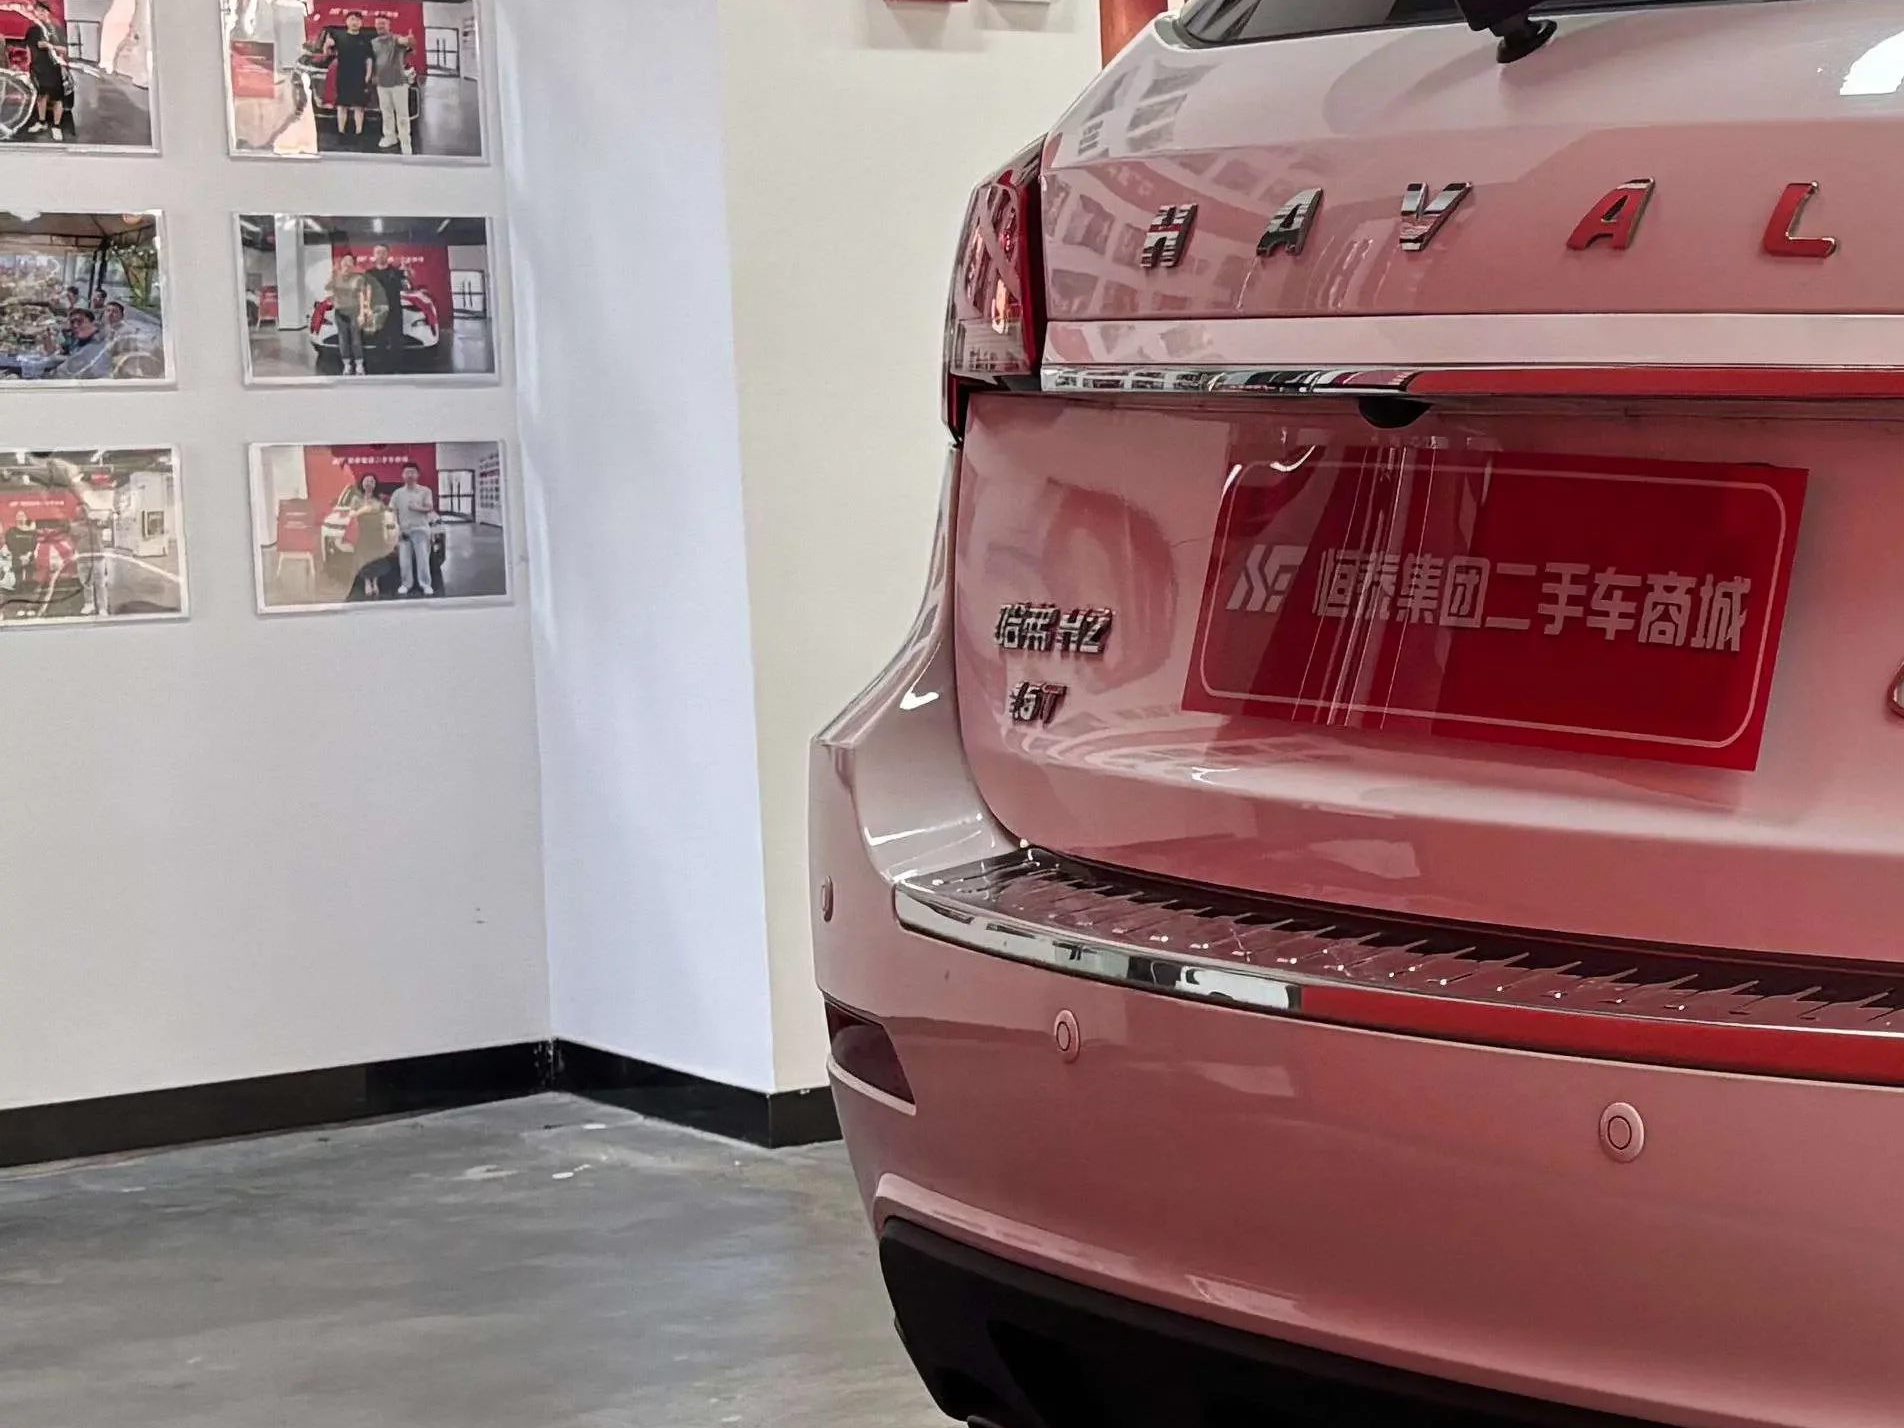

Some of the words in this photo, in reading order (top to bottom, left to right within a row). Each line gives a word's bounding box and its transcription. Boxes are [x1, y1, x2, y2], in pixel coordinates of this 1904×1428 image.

[1140, 176, 1842, 270] HAVAL
[1312, 547, 1753, 653] 恒泰集团二手车商城
